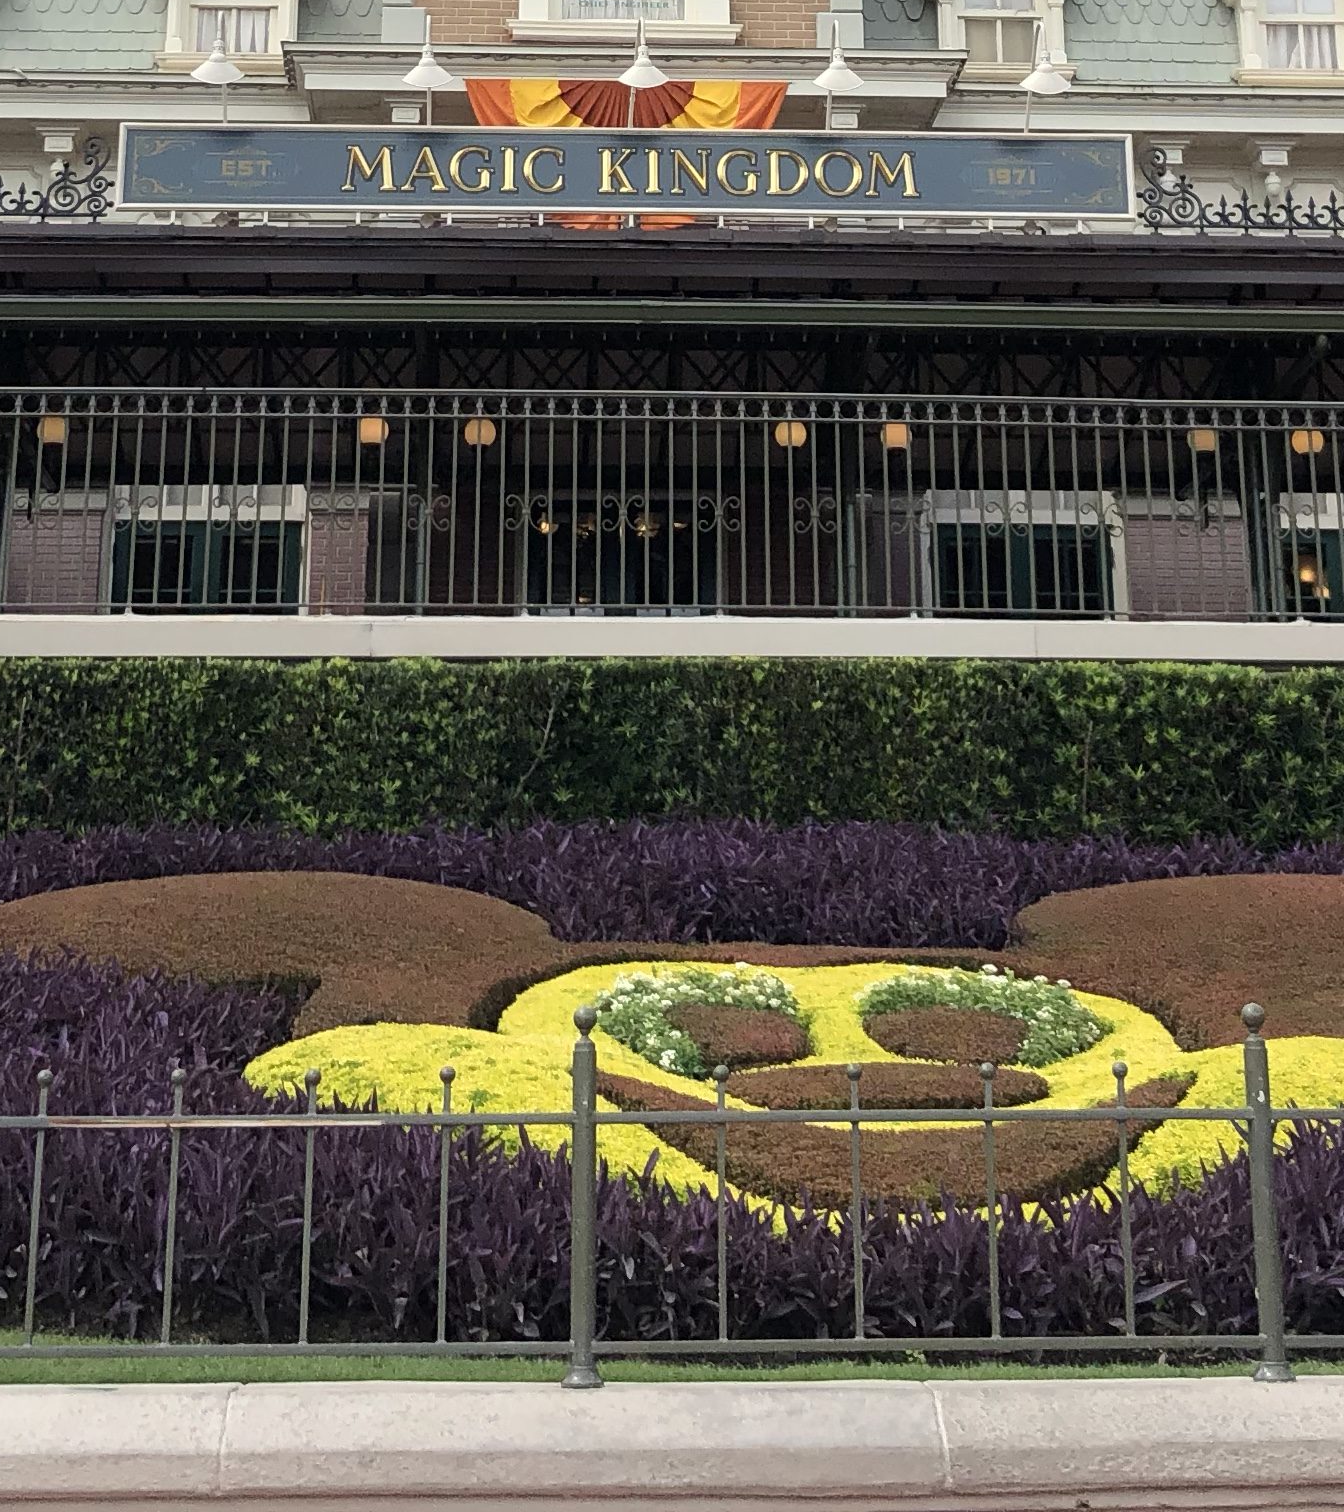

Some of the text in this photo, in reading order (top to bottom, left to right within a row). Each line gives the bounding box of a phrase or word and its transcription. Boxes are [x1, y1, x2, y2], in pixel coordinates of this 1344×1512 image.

[340, 144, 922, 198] MAGIC KINGDOM
[987, 167, 1036, 186] 1971
